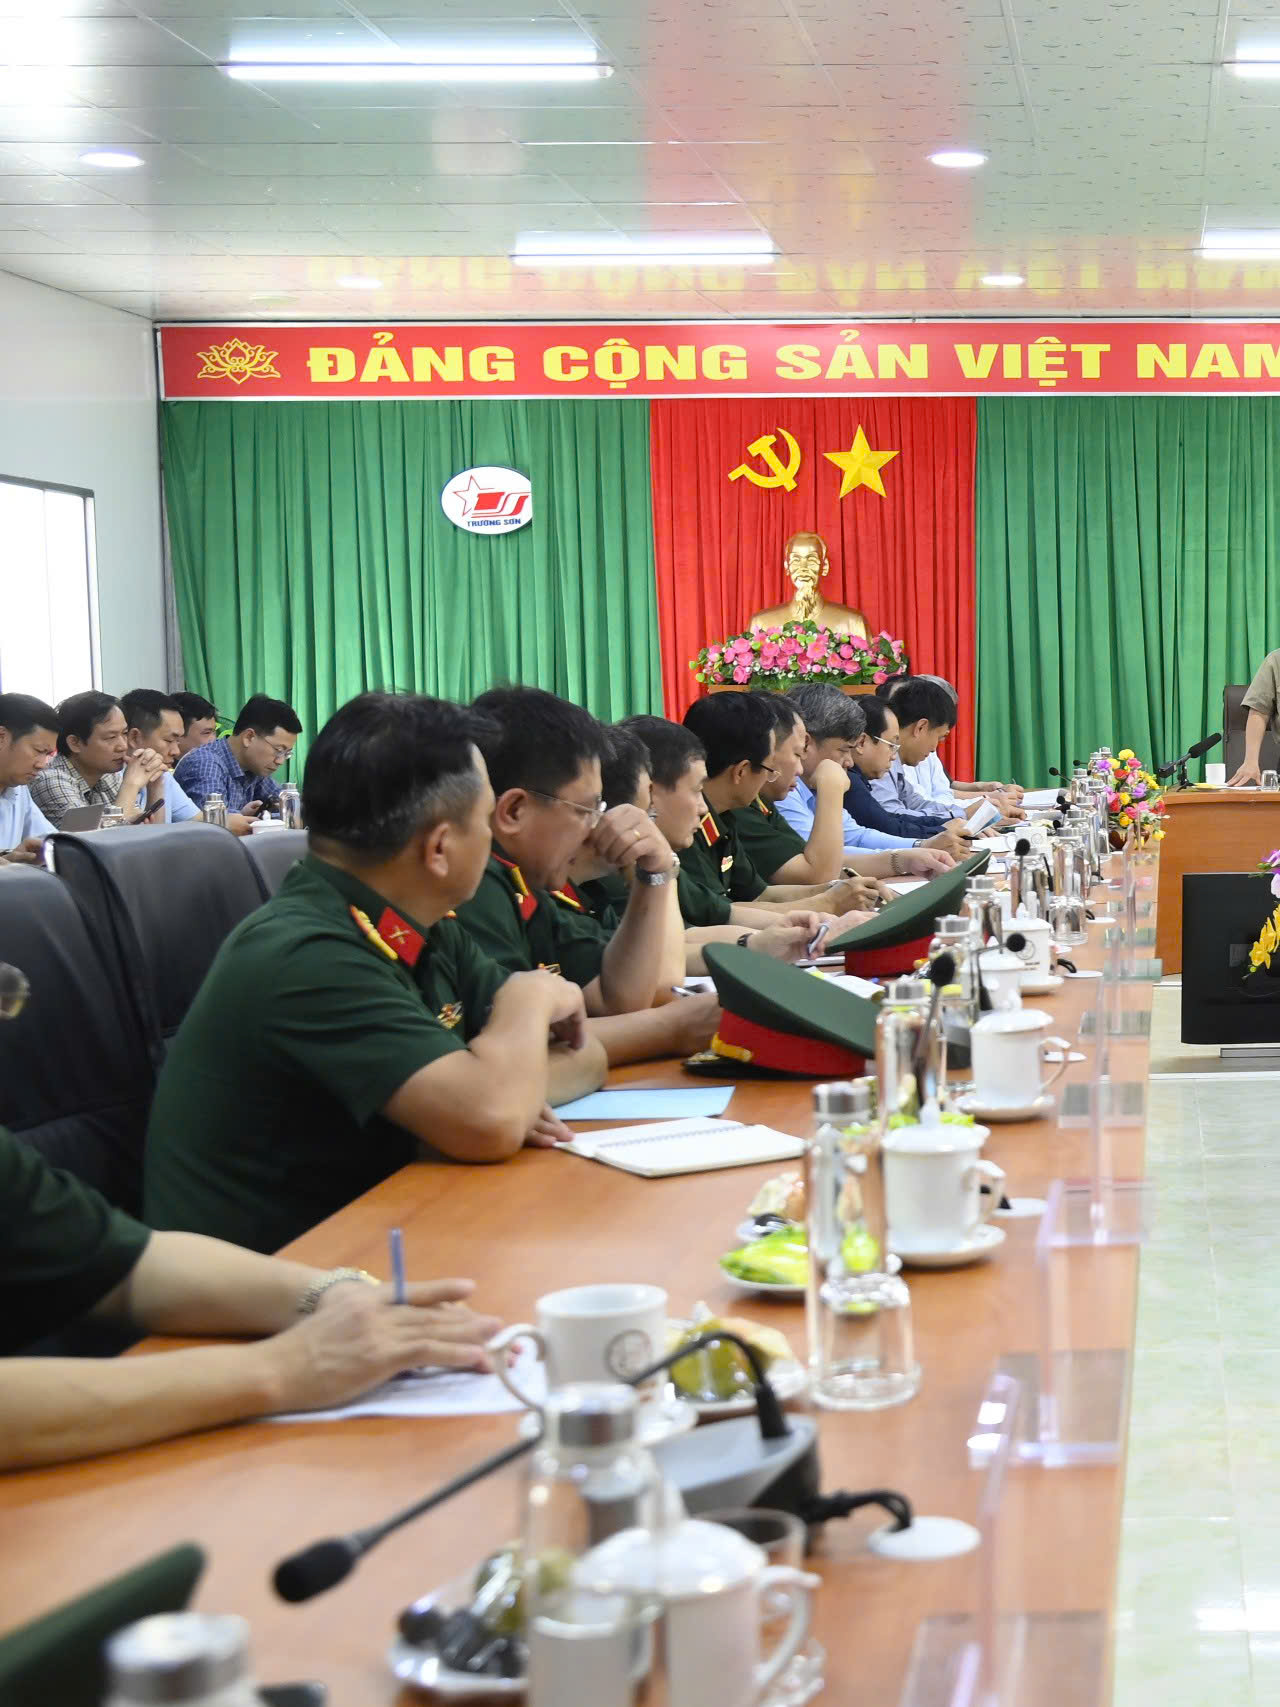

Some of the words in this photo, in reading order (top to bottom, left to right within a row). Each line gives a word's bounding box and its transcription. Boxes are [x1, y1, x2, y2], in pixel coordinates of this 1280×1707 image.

[306, 331, 516, 383] ĐẢNG
[543, 338, 748, 389] CỘNG
[775, 329, 929, 380] SẢN
[953, 336, 1111, 387] VIỆT
